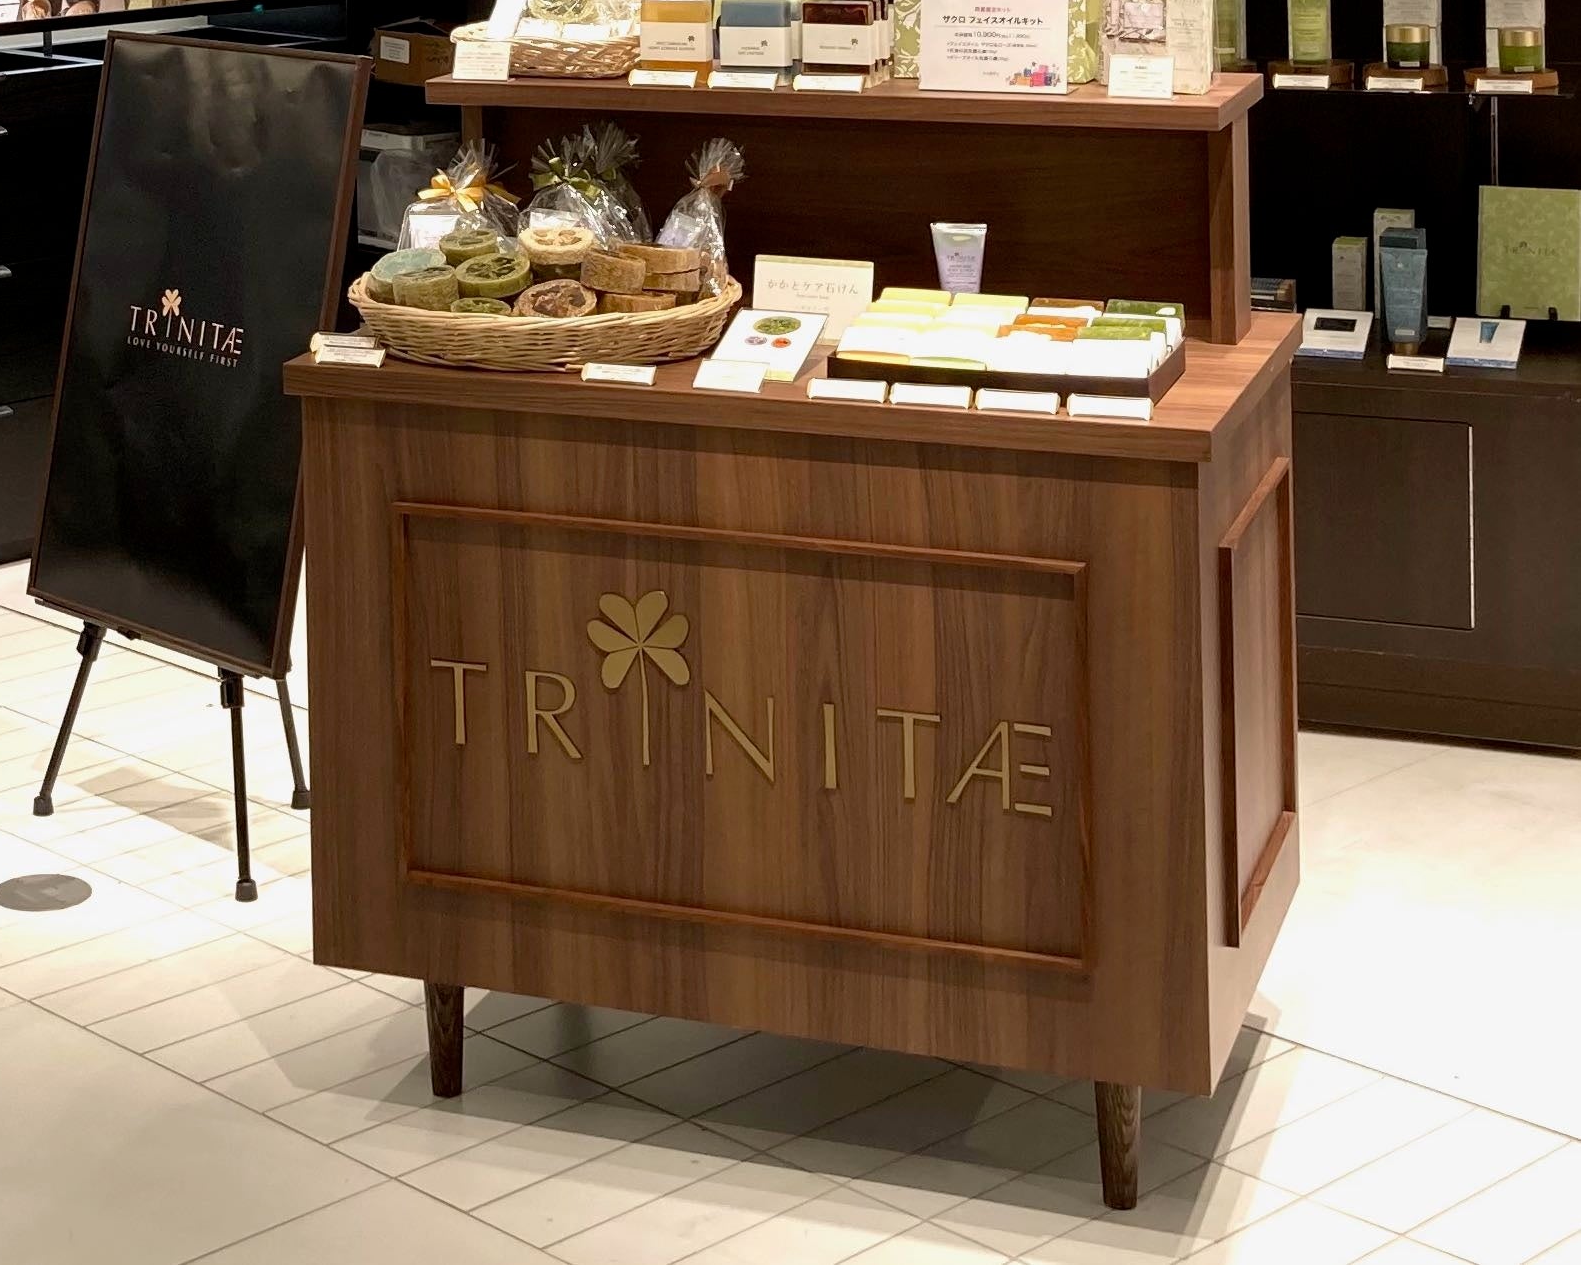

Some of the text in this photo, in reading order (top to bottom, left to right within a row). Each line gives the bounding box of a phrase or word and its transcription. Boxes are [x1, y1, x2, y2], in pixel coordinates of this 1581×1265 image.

[941, 14, 1044, 26] ザクロ フェイスオイルキット
[130, 305, 244, 355] TRINITÆ
[127, 335, 238, 368] LOVE YOURSELF FIRST
[430, 645, 1053, 817] TRINITÆ
